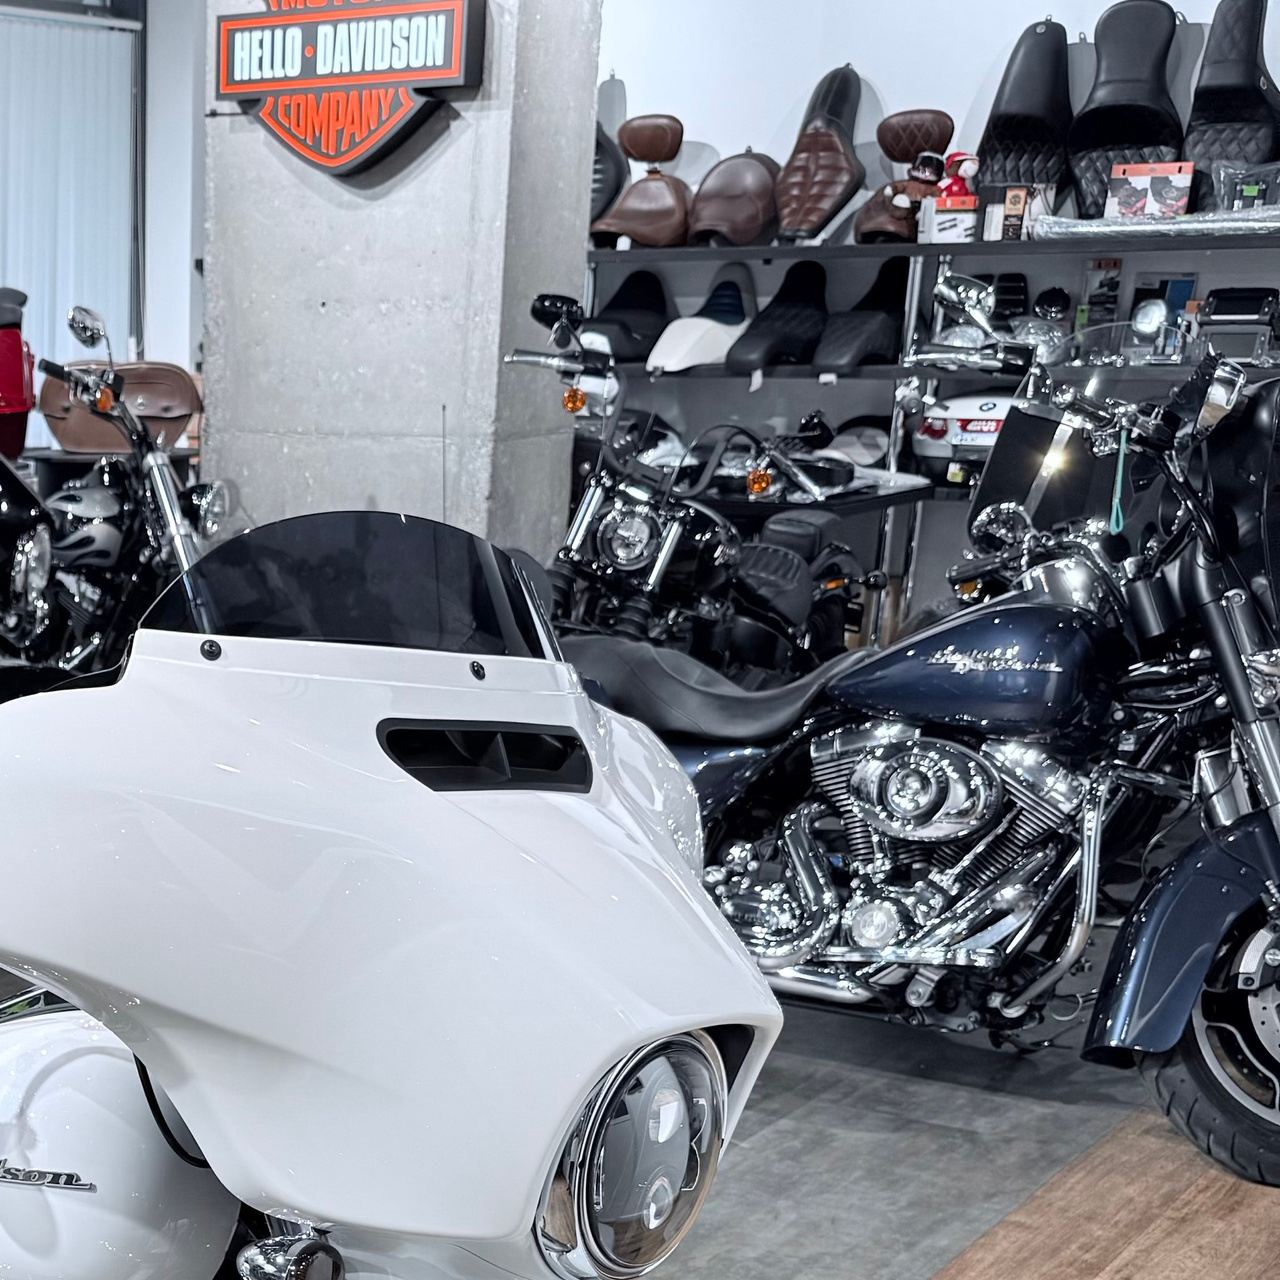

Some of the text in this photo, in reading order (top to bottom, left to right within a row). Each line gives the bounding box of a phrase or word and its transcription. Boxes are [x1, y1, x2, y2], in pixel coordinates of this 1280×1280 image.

[234, 15, 446, 81] HELLO DAVIDSON
[278, 87, 396, 155] COMPANY
